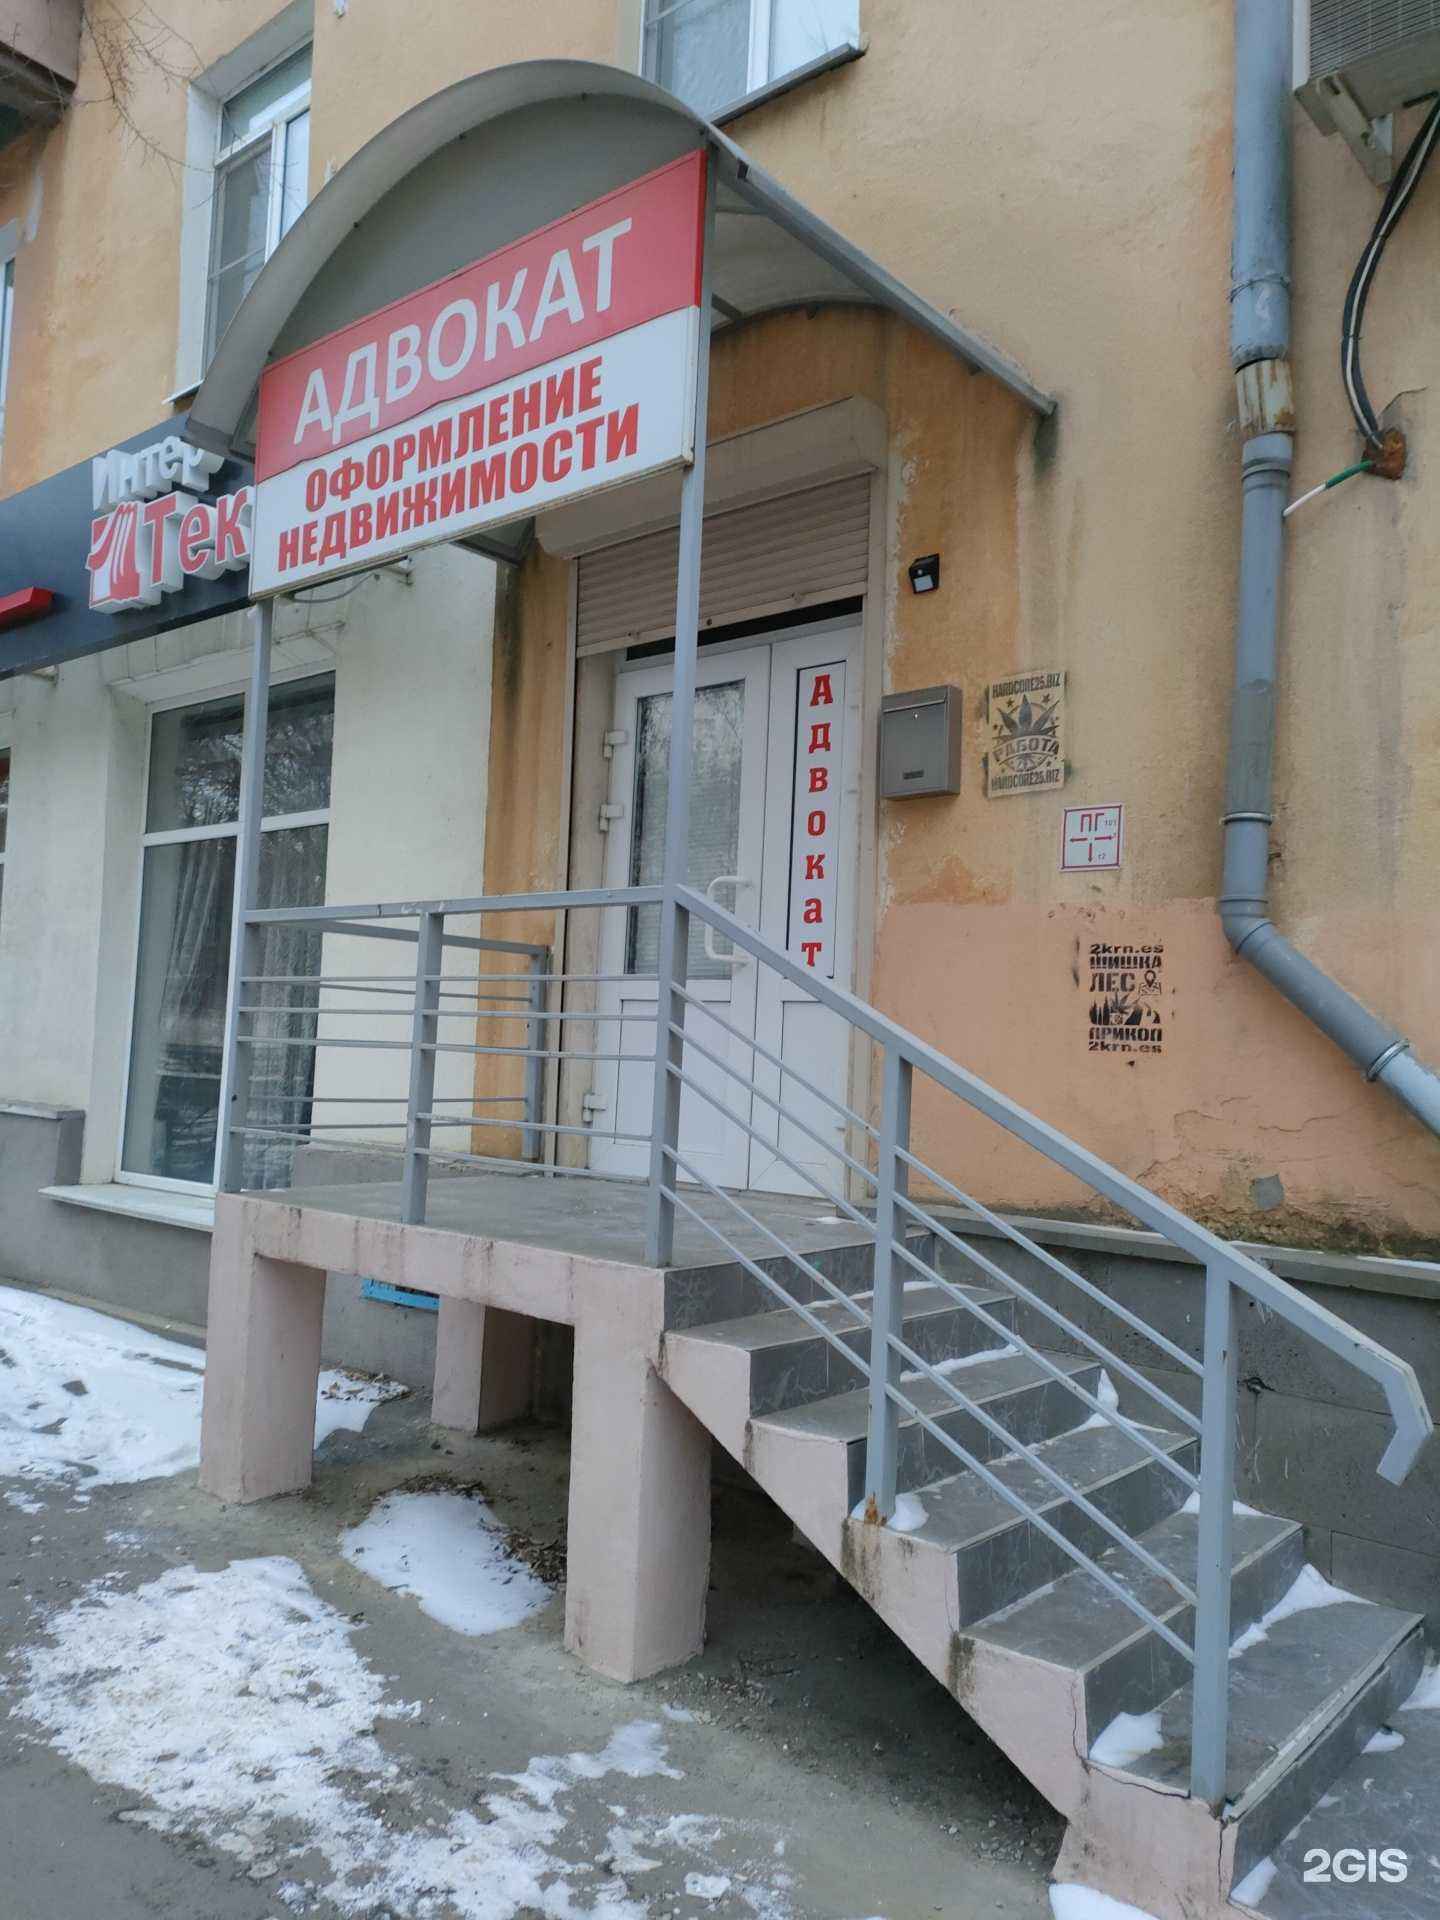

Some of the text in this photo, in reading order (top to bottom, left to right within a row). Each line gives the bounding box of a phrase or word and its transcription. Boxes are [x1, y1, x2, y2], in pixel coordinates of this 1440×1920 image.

[293, 217, 633, 446] АДВОКАТ
[305, 355, 604, 514] ОФОРМЛЕНИЕ
[277, 402, 640, 573] НЕДВИЖИМОСТИ
[993, 738, 1060, 762] РАБОТА
[1080, 813, 1105, 832] ПГ
[1090, 943, 1164, 954] 2krn.es
[1089, 955, 1162, 970] ШИШКА
[1089, 972, 1136, 992] ЛЕС
[1088, 1040, 1162, 1053] 2krn.es
